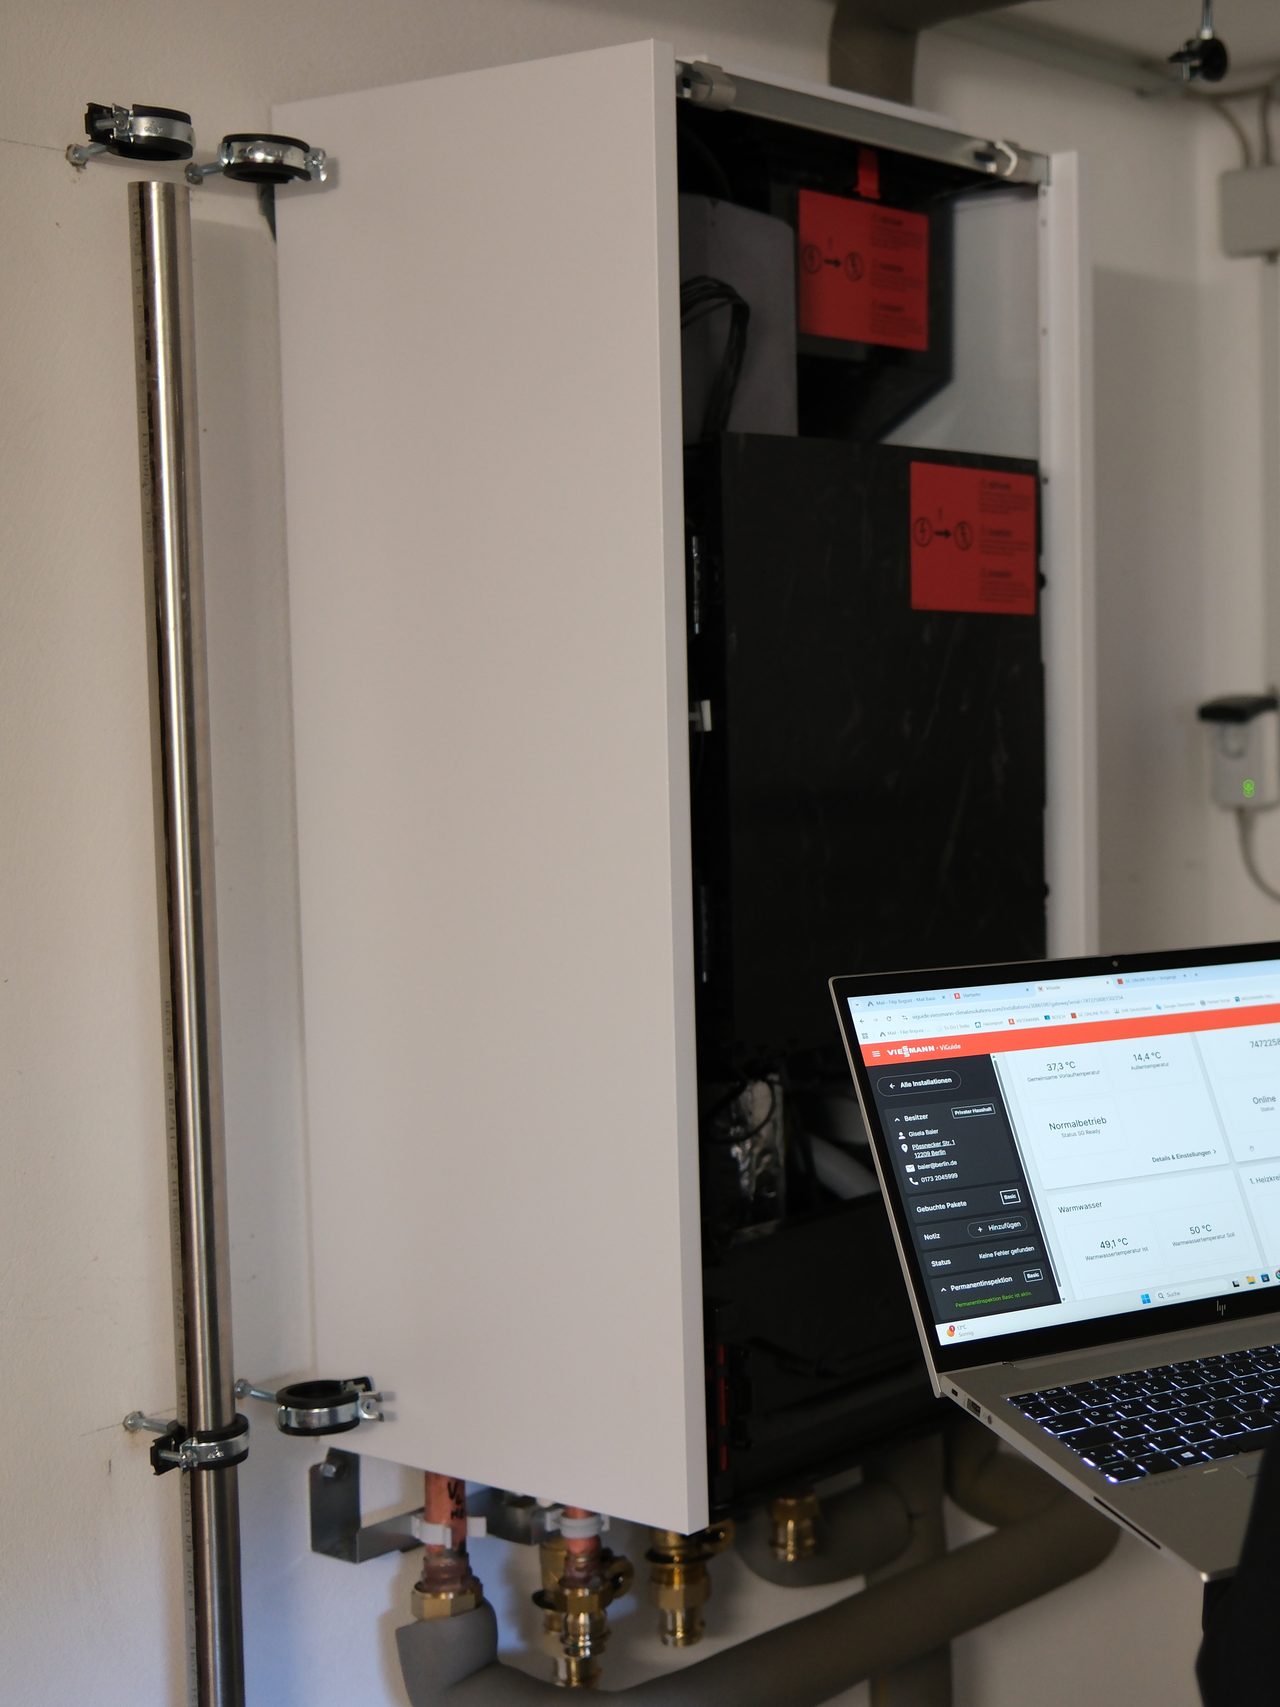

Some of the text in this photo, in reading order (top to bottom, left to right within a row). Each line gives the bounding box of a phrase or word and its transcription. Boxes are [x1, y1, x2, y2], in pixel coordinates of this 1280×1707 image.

[887, 1045, 935, 1057] VIESSMANN
[1133, 1053, 1150, 1062] 14,4
[1046, 1062, 1064, 1072] 37,3
[912, 1077, 953, 1087] Installationen
[1252, 1095, 1276, 1105] Online
[904, 1114, 929, 1122] Besitzer
[1049, 1116, 1107, 1131] Normalbetrieb
[1152, 1155, 1171, 1163] Details
[1176, 1150, 1211, 1159] Einstellungen
[920, 1175, 934, 1183] 0173
[916, 1201, 967, 1213] Gebuchte Pakete
[1058, 1201, 1103, 1213] Warmwasser
[988, 1221, 1022, 1231] Hinzufügen
[1189, 1224, 1212, 1235] 50 °C
[923, 1233, 940, 1241] Notiz
[1100, 1237, 1129, 1250] 49,1 °C
[994, 1249, 1010, 1257] Fehler
[1010, 1246, 1035, 1256] gefunden
[1085, 1248, 1141, 1261] Warmwassertemperatur
[931, 1259, 951, 1268] Status
[950, 1276, 1013, 1291] Permanentinspektion
